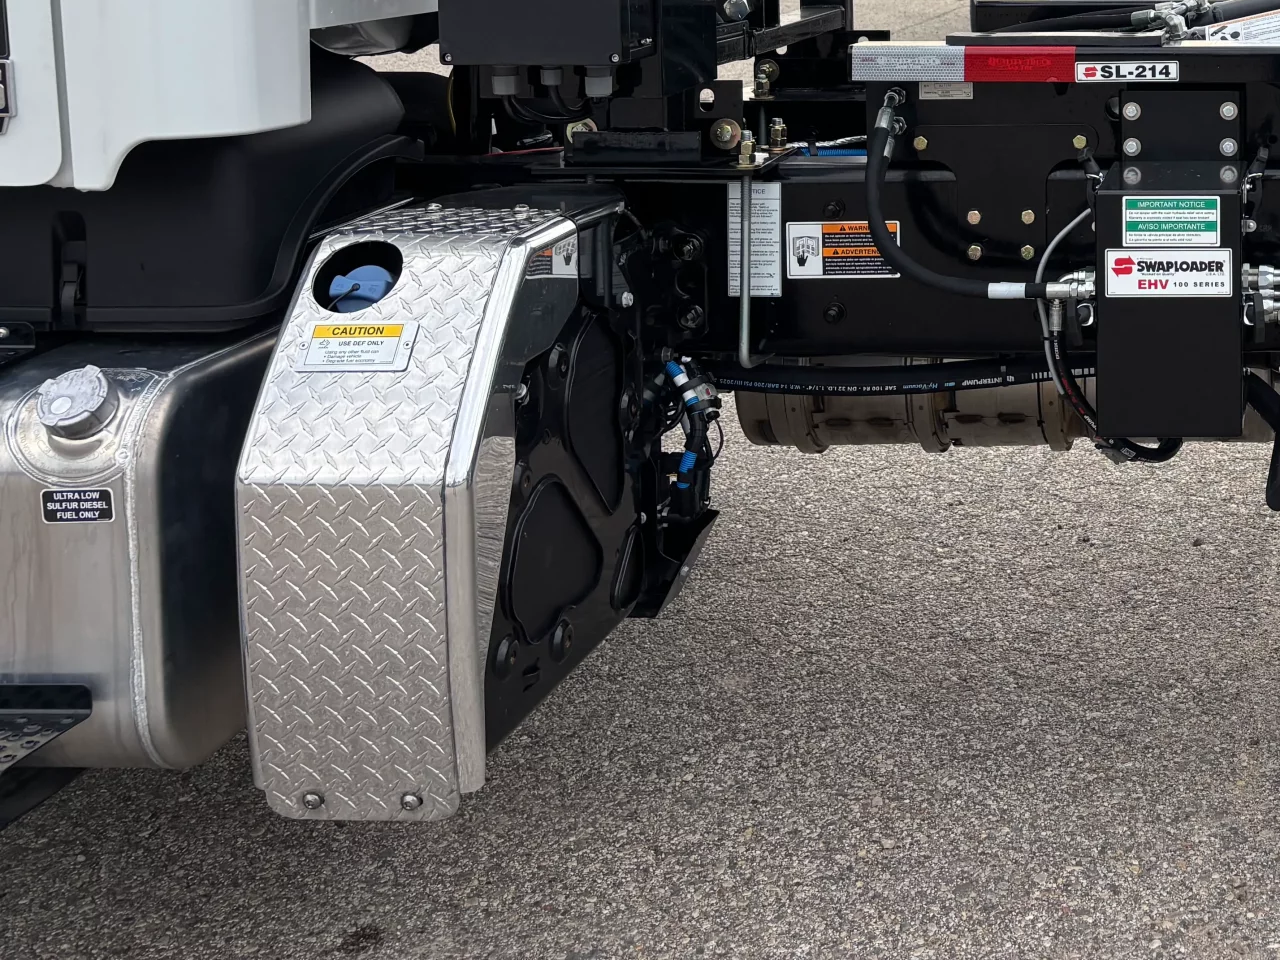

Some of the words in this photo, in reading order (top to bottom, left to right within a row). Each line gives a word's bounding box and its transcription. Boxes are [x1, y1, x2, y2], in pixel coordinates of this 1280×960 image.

[1100, 64, 1171, 79] SL-214
[1136, 260, 1224, 272] SWAPLOADER
[1138, 279, 1170, 290] EHV
[332, 326, 385, 336] CAUTION
[962, 376, 1003, 386] INTERPUMP
[53, 492, 80, 500] ULTRA
[80, 492, 100, 500] LOW
[46, 502, 78, 510] SULFUR
[80, 501, 108, 509] DIESEL
[78, 510, 100, 518] ONLY
